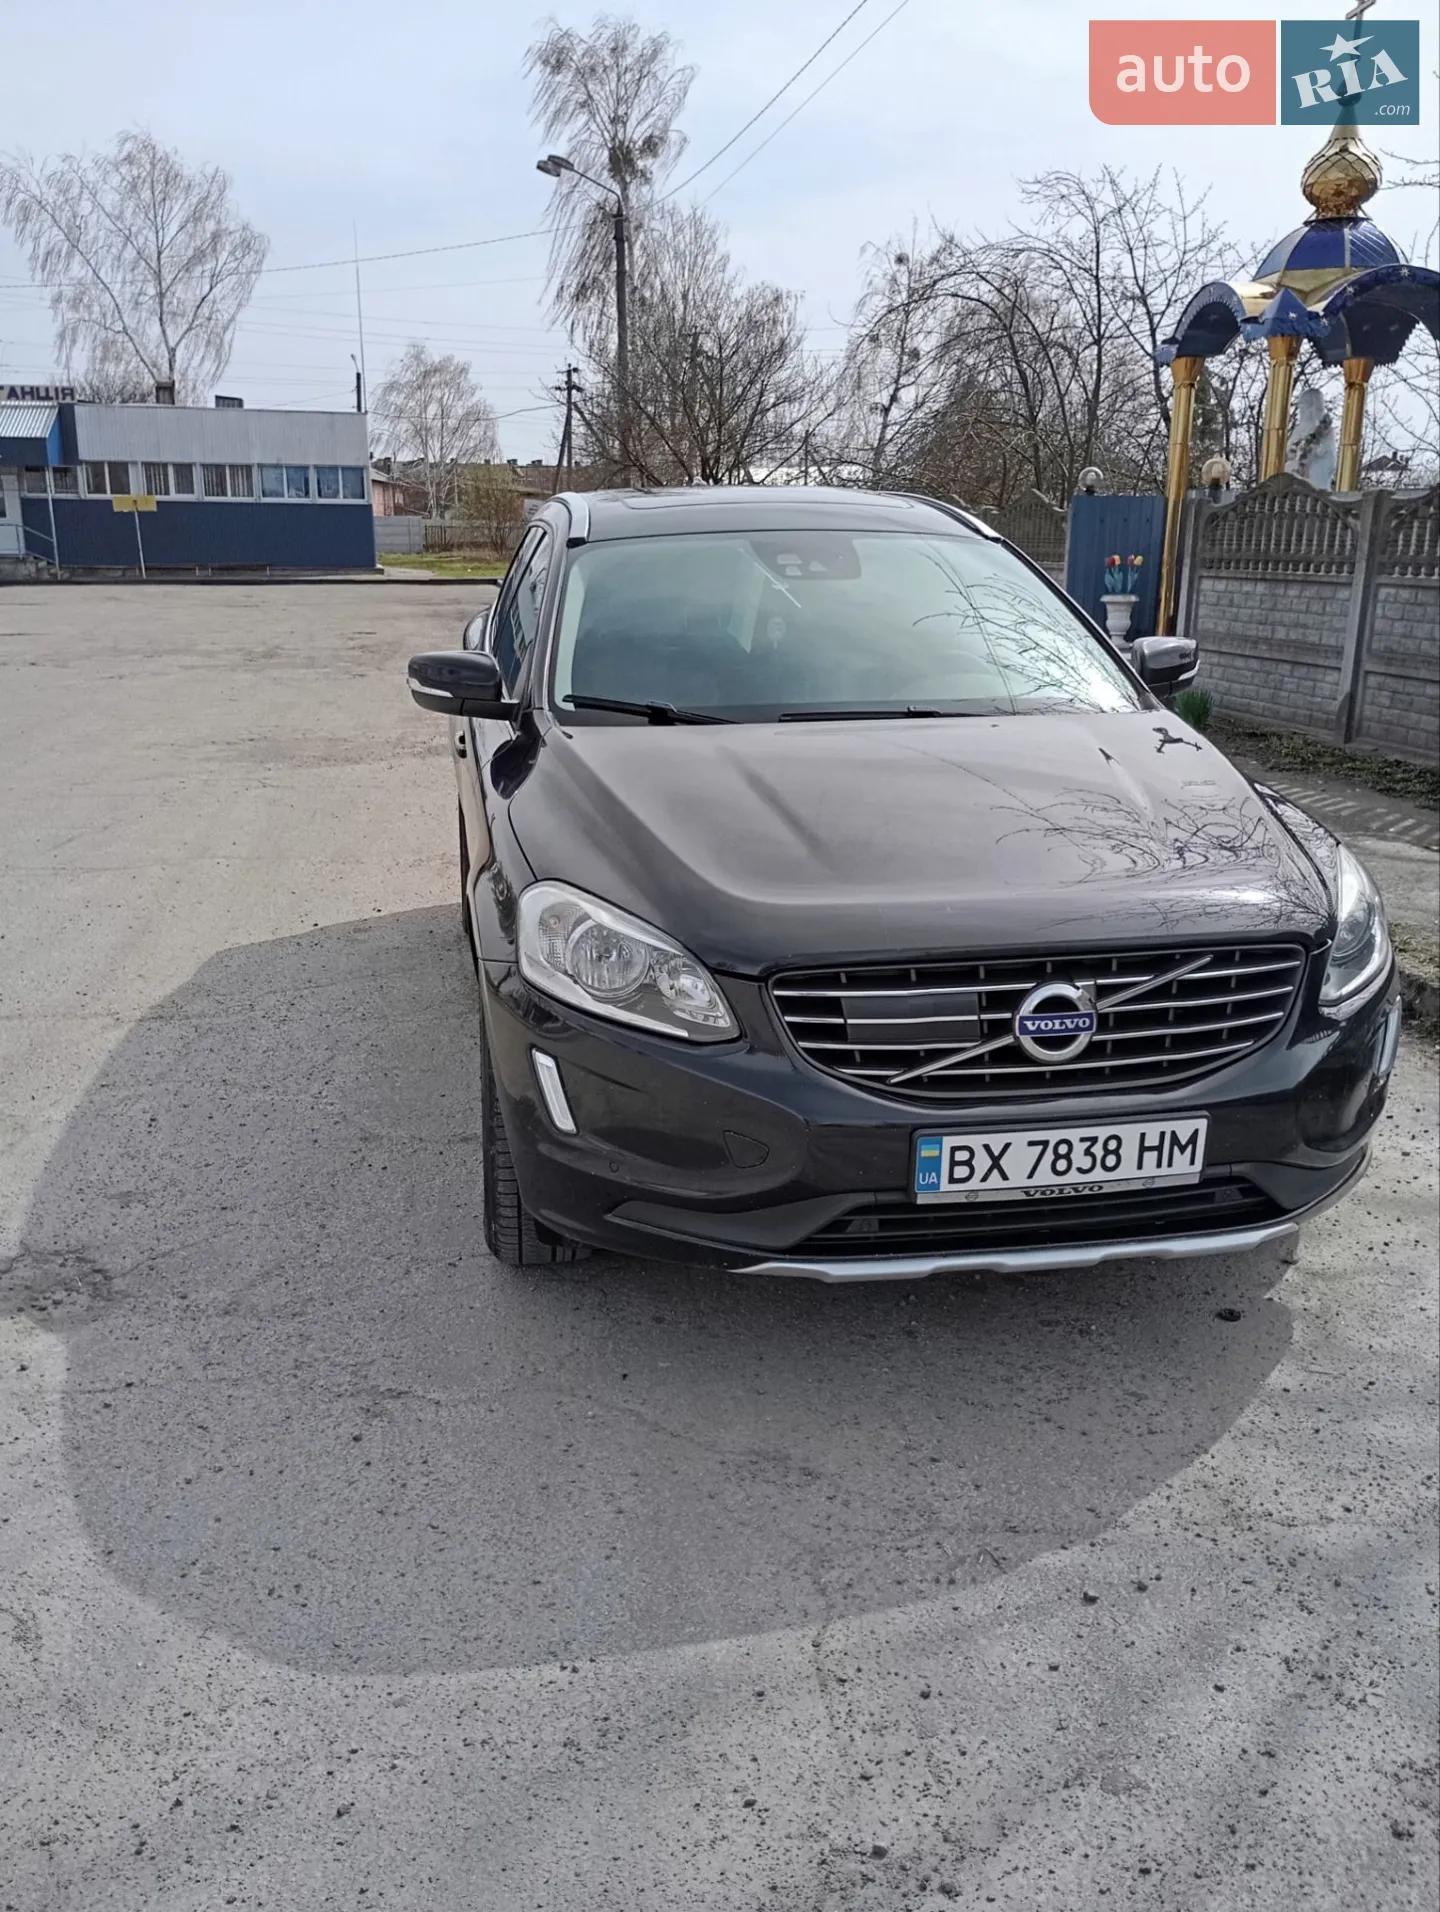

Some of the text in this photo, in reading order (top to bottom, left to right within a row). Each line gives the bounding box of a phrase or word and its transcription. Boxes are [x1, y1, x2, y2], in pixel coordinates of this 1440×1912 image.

[0, 385, 75, 400] АНЦІЯ
[1023, 1017, 1090, 1031] VOLVO
[948, 1128, 1200, 1185] BX 7838 HM
[919, 1172, 938, 1184] UA
[1021, 1184, 1104, 1197] VOLVO
